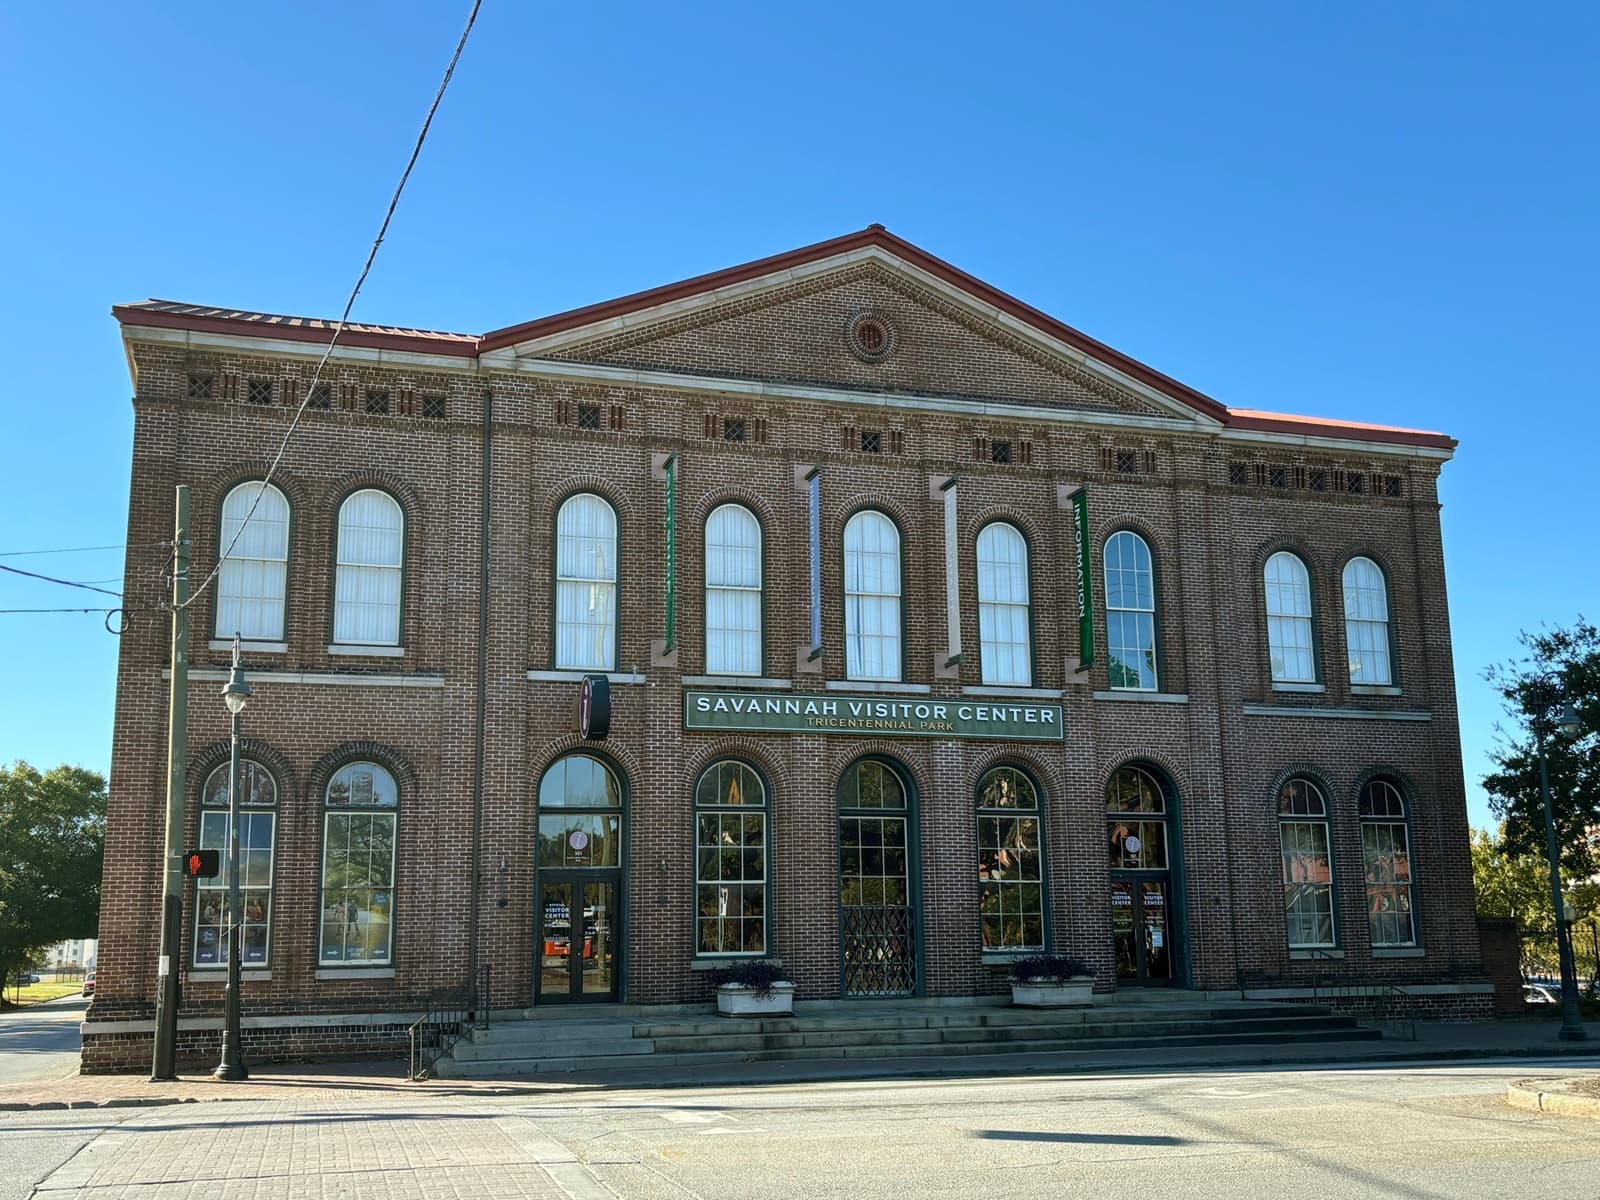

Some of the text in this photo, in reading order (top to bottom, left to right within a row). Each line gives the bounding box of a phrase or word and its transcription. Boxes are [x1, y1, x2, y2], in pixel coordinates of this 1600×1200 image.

[1074, 503, 1085, 618] INFORMATION
[696, 697, 1055, 724] SAVANNAH VISITOR CENTER
[806, 717, 954, 731] TRICENTENNIAL PARK
